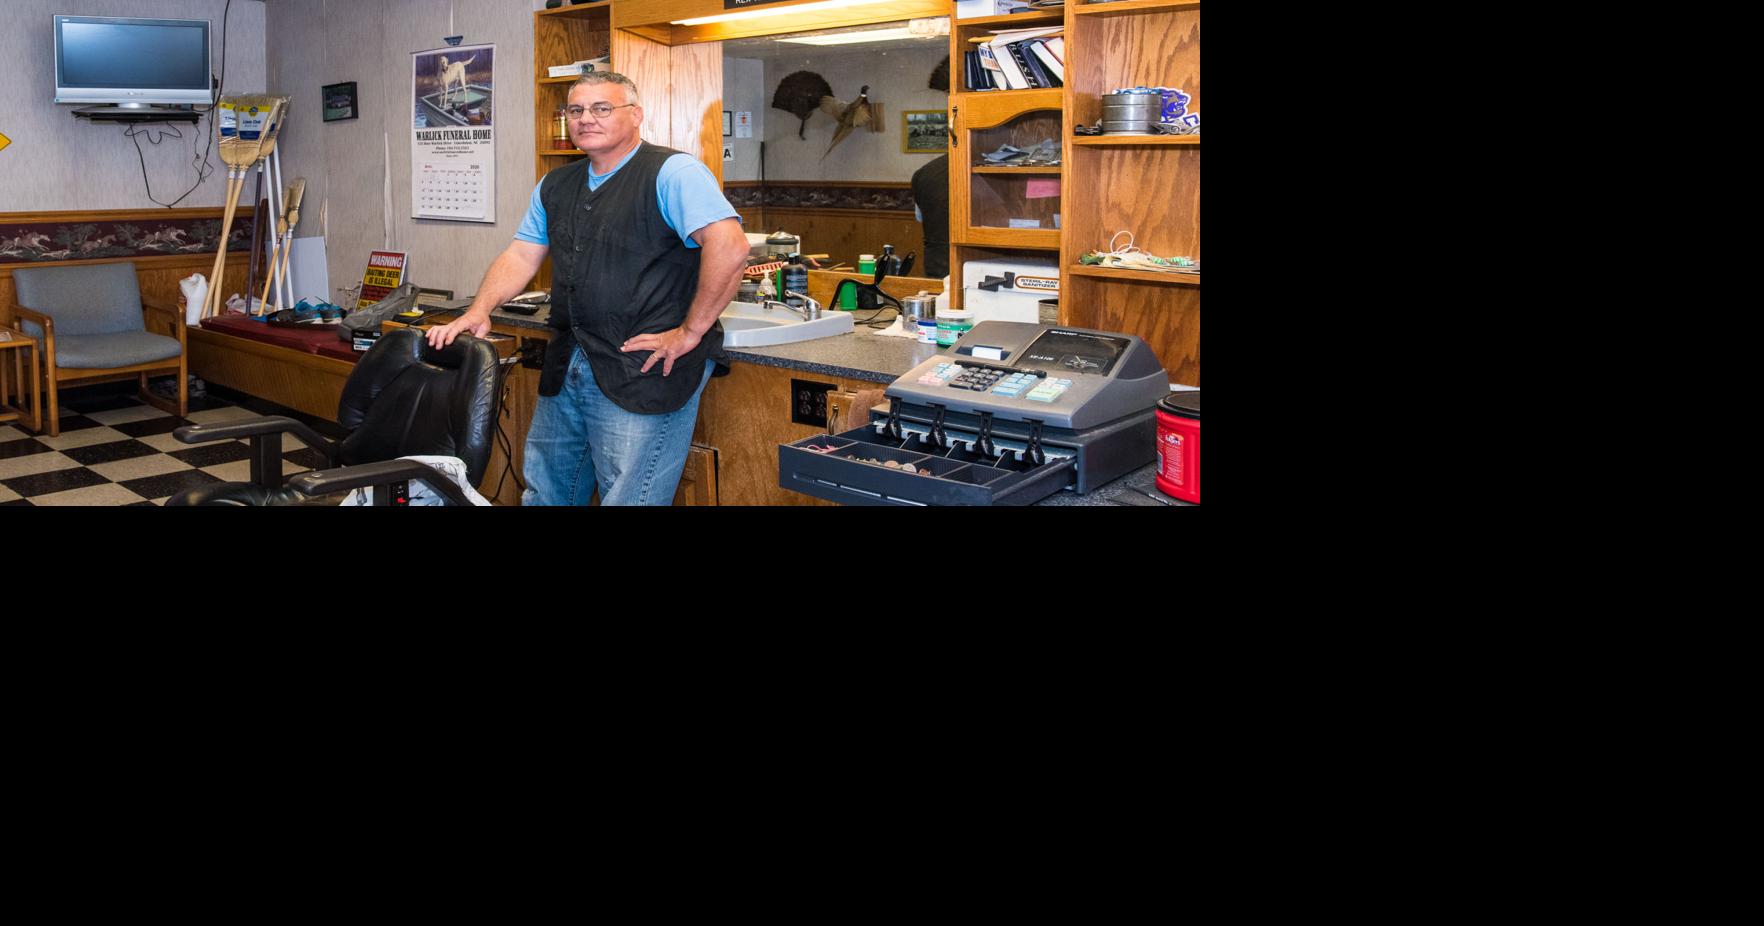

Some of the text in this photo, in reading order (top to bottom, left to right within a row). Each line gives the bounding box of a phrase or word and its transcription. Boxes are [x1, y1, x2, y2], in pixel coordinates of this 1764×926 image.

[416, 130, 491, 141] WARLICK FUNERAL HOME
[371, 255, 402, 267] WARNING
[367, 268, 400, 278] BAITING DEER
[375, 277, 393, 285] ILLEGAL
